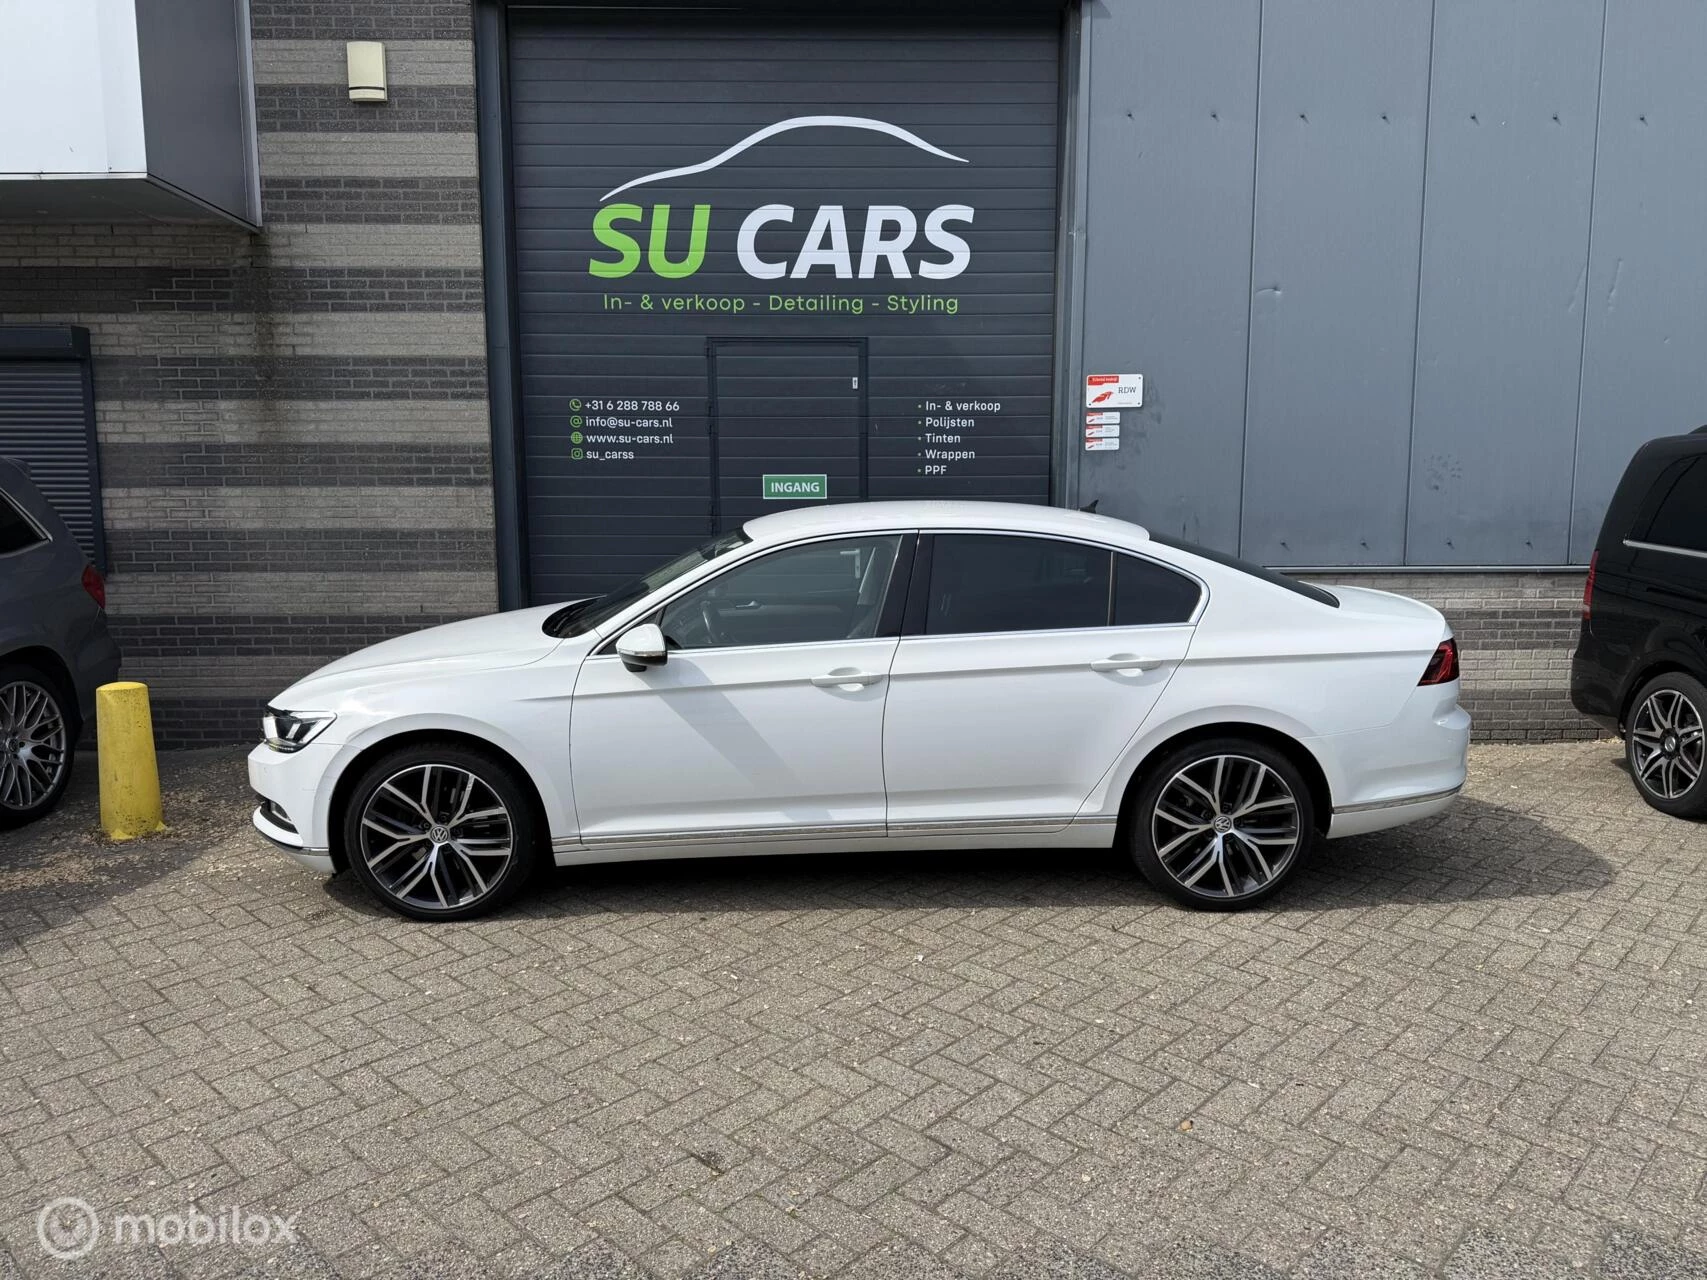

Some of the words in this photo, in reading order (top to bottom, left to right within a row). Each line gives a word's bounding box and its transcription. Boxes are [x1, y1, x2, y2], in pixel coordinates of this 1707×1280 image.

[588, 203, 711, 279] SU
[737, 204, 975, 280] CARS
[603, 294, 632, 310] In-
[640, 294, 654, 310] &
[661, 294, 745, 314] verkoop
[769, 295, 863, 314] Detailing
[887, 295, 958, 314] Styling
[1118, 386, 1137, 394] RDW
[584, 400, 604, 411] +31
[606, 400, 614, 411] 6
[616, 400, 639, 411] 288
[641, 401, 663, 412] 788
[665, 401, 680, 412] 66
[925, 400, 942, 411] In-
[944, 400, 953, 411] &
[956, 400, 1001, 413] verkoop
[585, 416, 673, 429] info@su-cars.nl
[925, 416, 975, 429] Polijsten
[586, 433, 674, 444] www.su-cars.nl
[925, 433, 961, 443] Tinten
[586, 450, 635, 461] su_carss
[925, 449, 976, 461] Wrappen
[924, 465, 948, 475] PPF
[770, 481, 820, 493] INGANG
